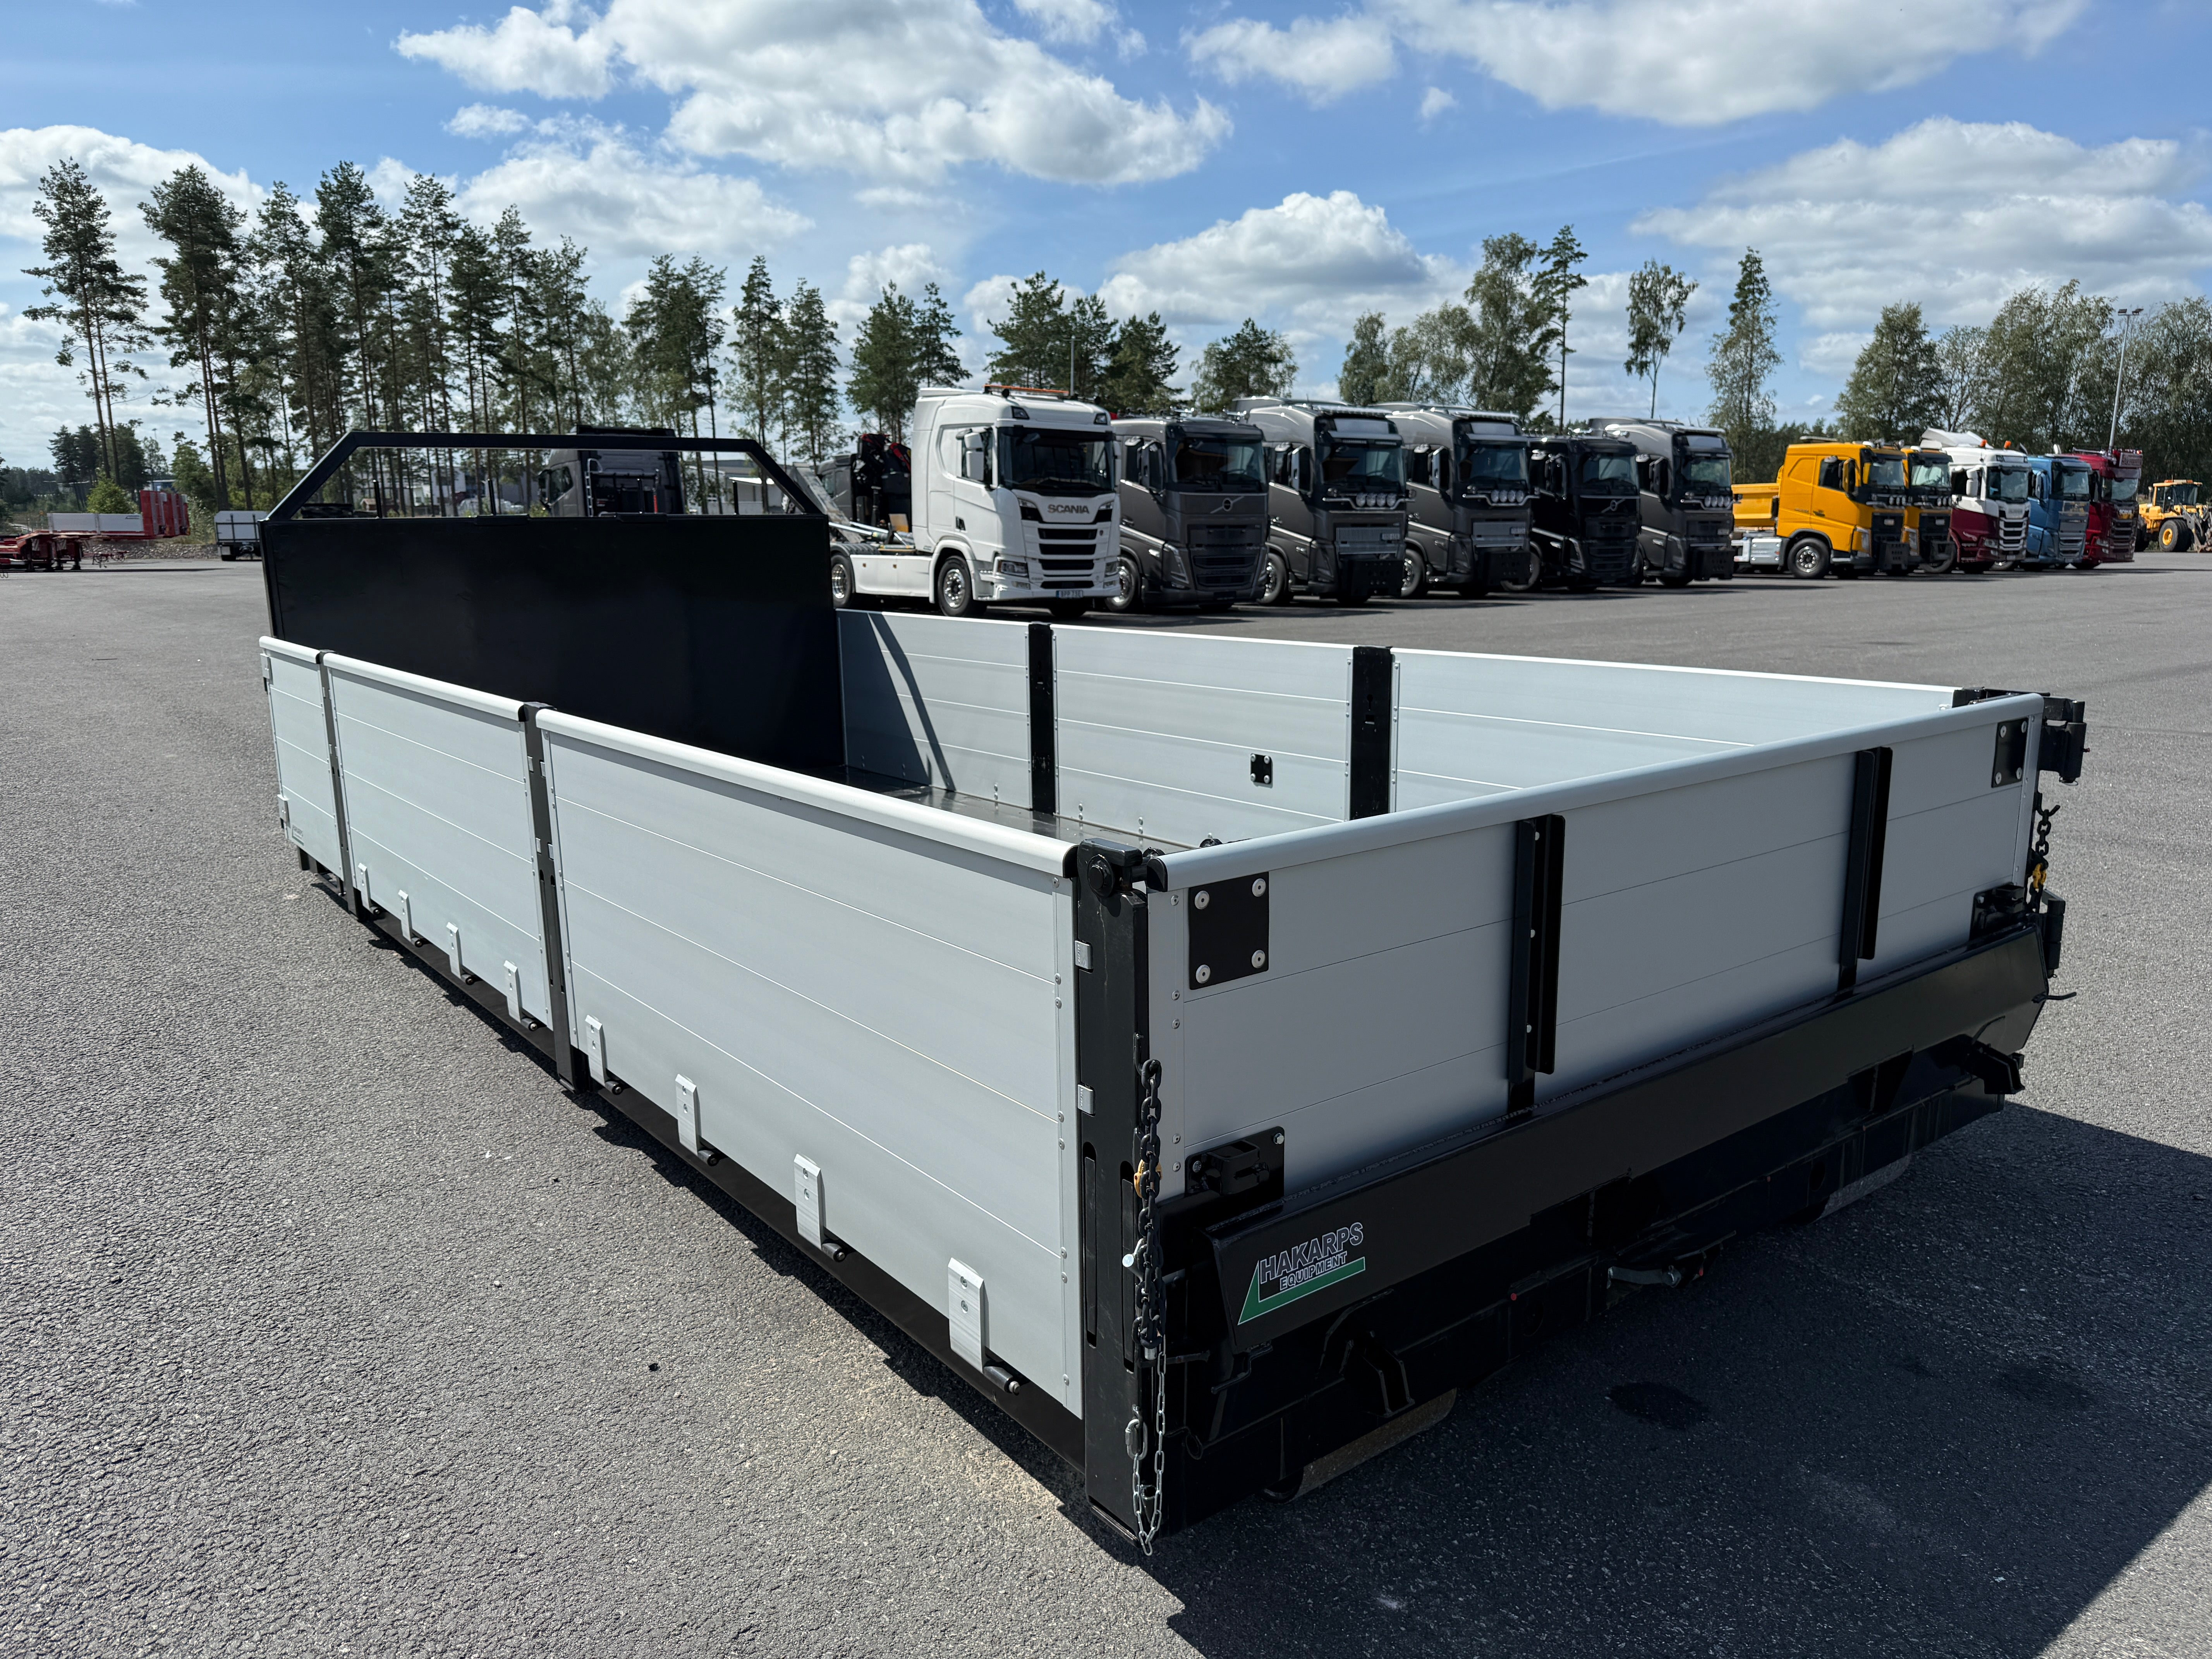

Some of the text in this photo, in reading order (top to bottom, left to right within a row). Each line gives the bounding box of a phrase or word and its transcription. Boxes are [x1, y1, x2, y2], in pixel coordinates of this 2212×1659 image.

[1047, 504, 1090, 514] SCANIA
[1260, 1222, 1364, 1284] HAKARPS
[1280, 1251, 1347, 1291] EQUIPMENT
